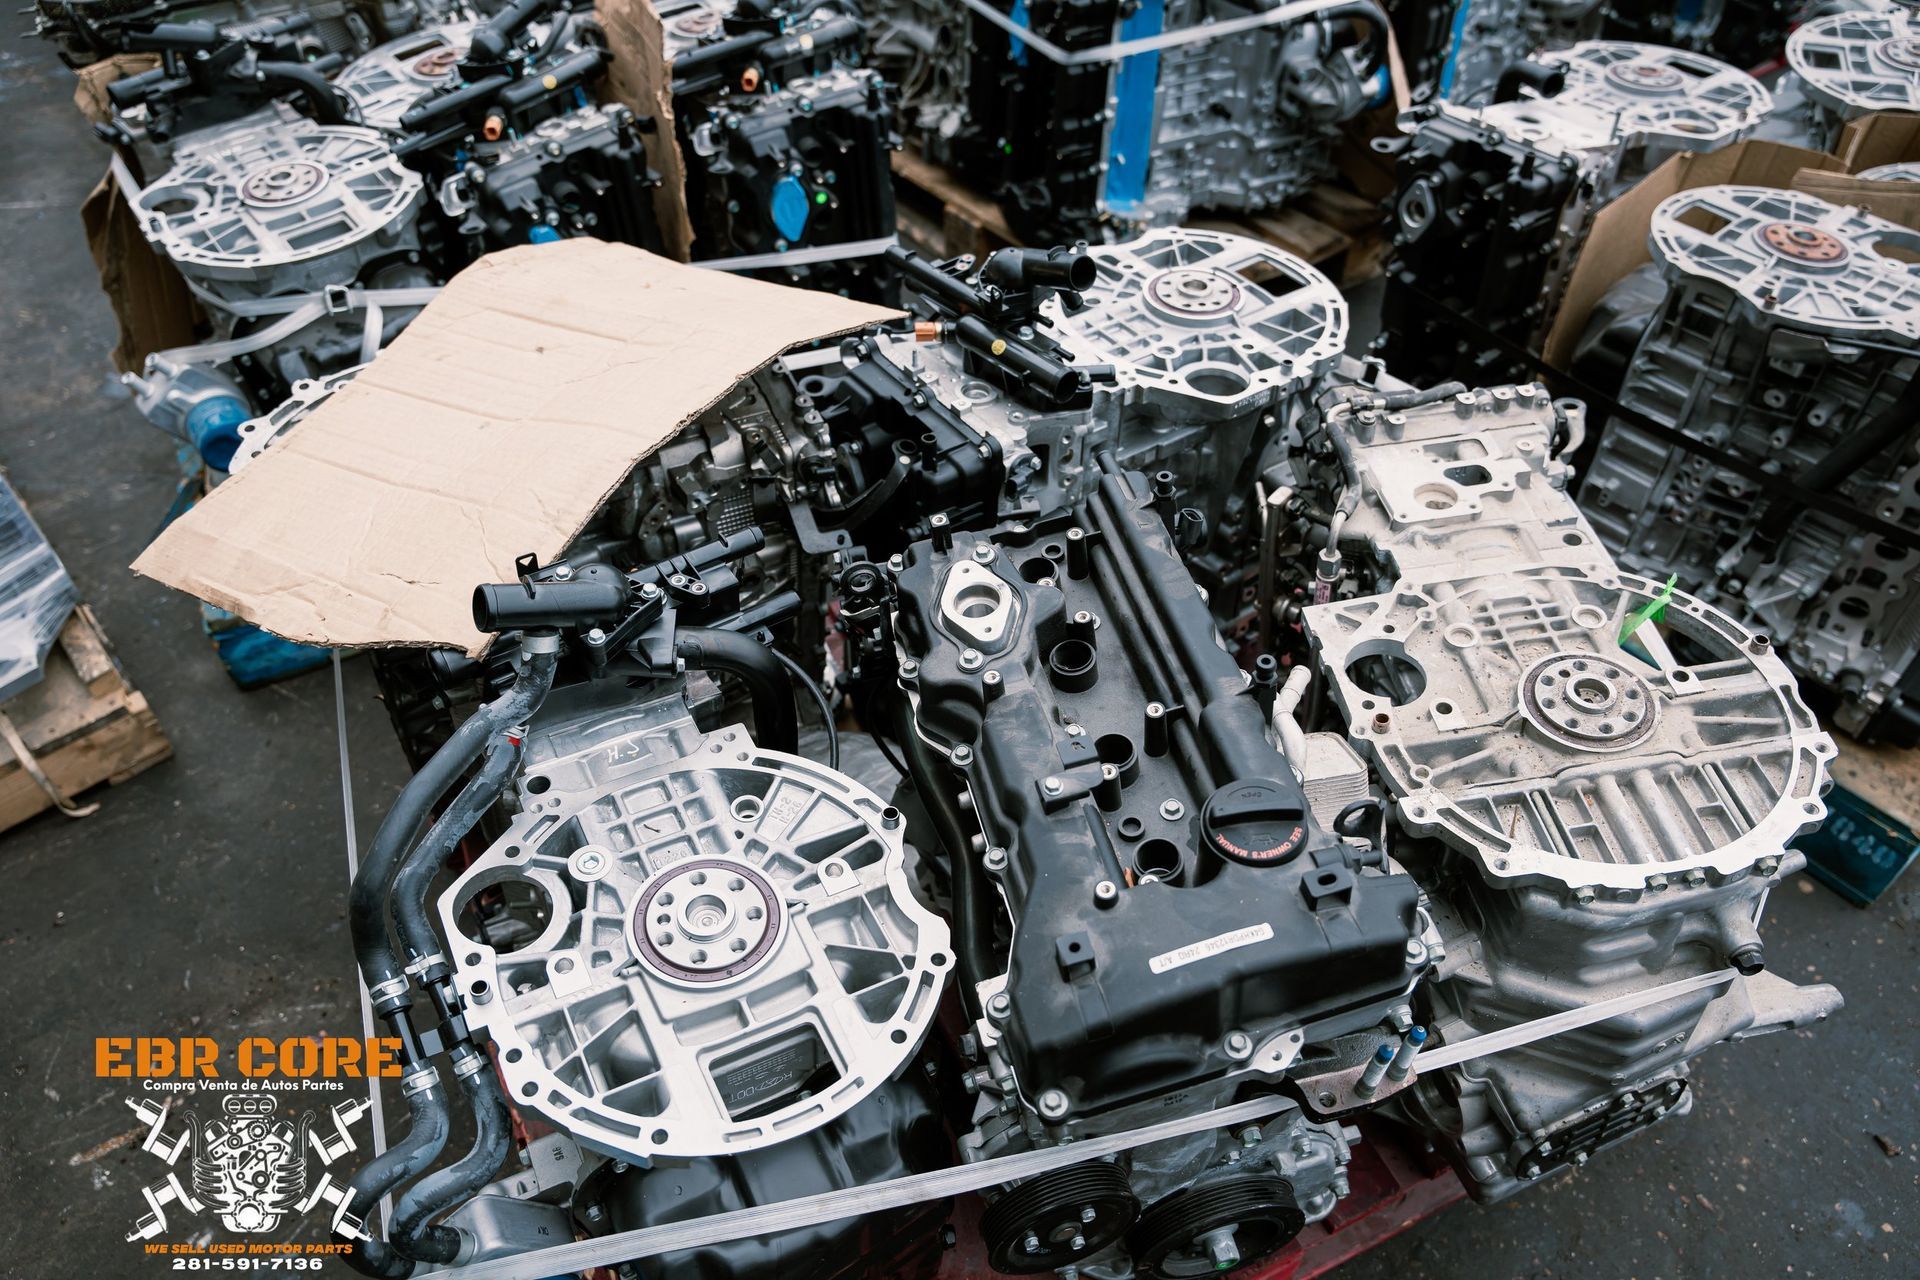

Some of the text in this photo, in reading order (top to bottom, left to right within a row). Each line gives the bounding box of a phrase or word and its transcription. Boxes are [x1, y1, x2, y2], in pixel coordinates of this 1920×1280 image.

[1215, 826, 1304, 860] SEE OWNER'S MANUAL
